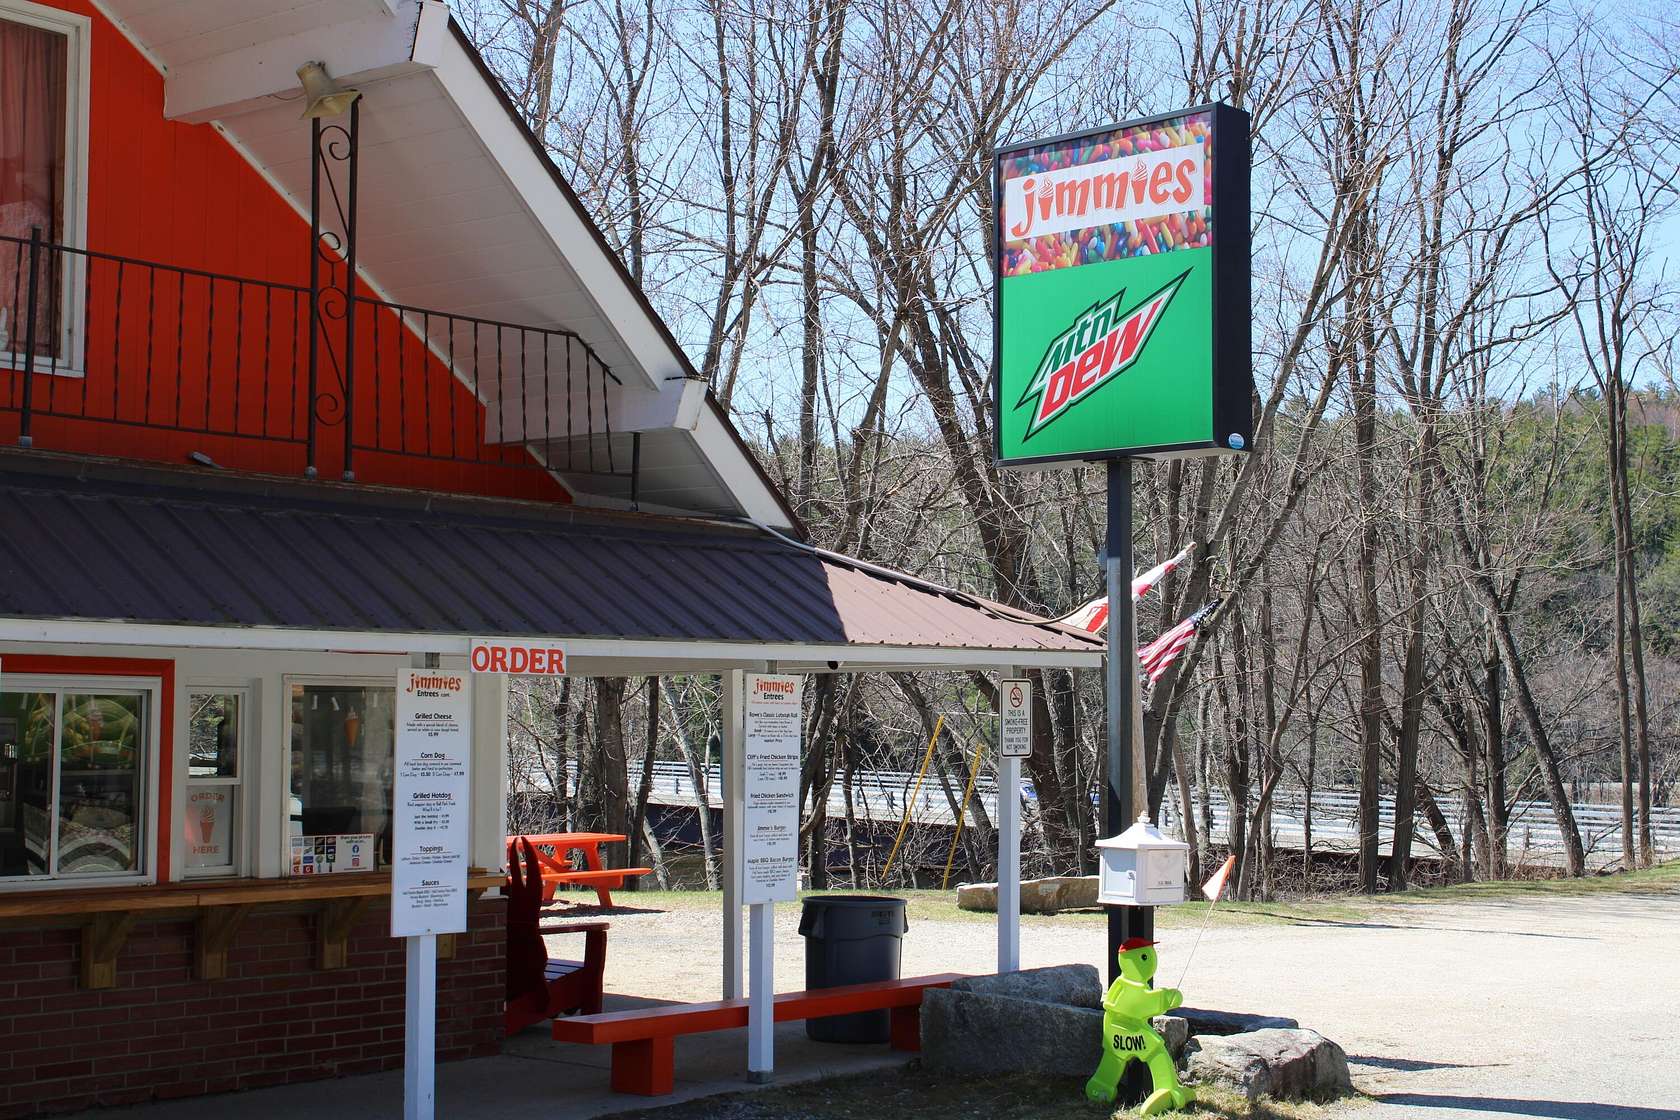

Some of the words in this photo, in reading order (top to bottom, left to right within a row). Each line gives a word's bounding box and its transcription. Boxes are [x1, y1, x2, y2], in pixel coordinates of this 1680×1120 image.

[1011, 158, 1197, 238] jimmies
[472, 646, 565, 674] ORDER
[406, 673, 462, 692] jimmies
[753, 678, 795, 695] jimmies
[434, 752, 446, 760] Dog
[431, 792, 452, 800] Hotdog
[192, 846, 220, 855] HERE
[419, 846, 444, 854] Toppings
[1113, 1034, 1146, 1051] SLOW!
